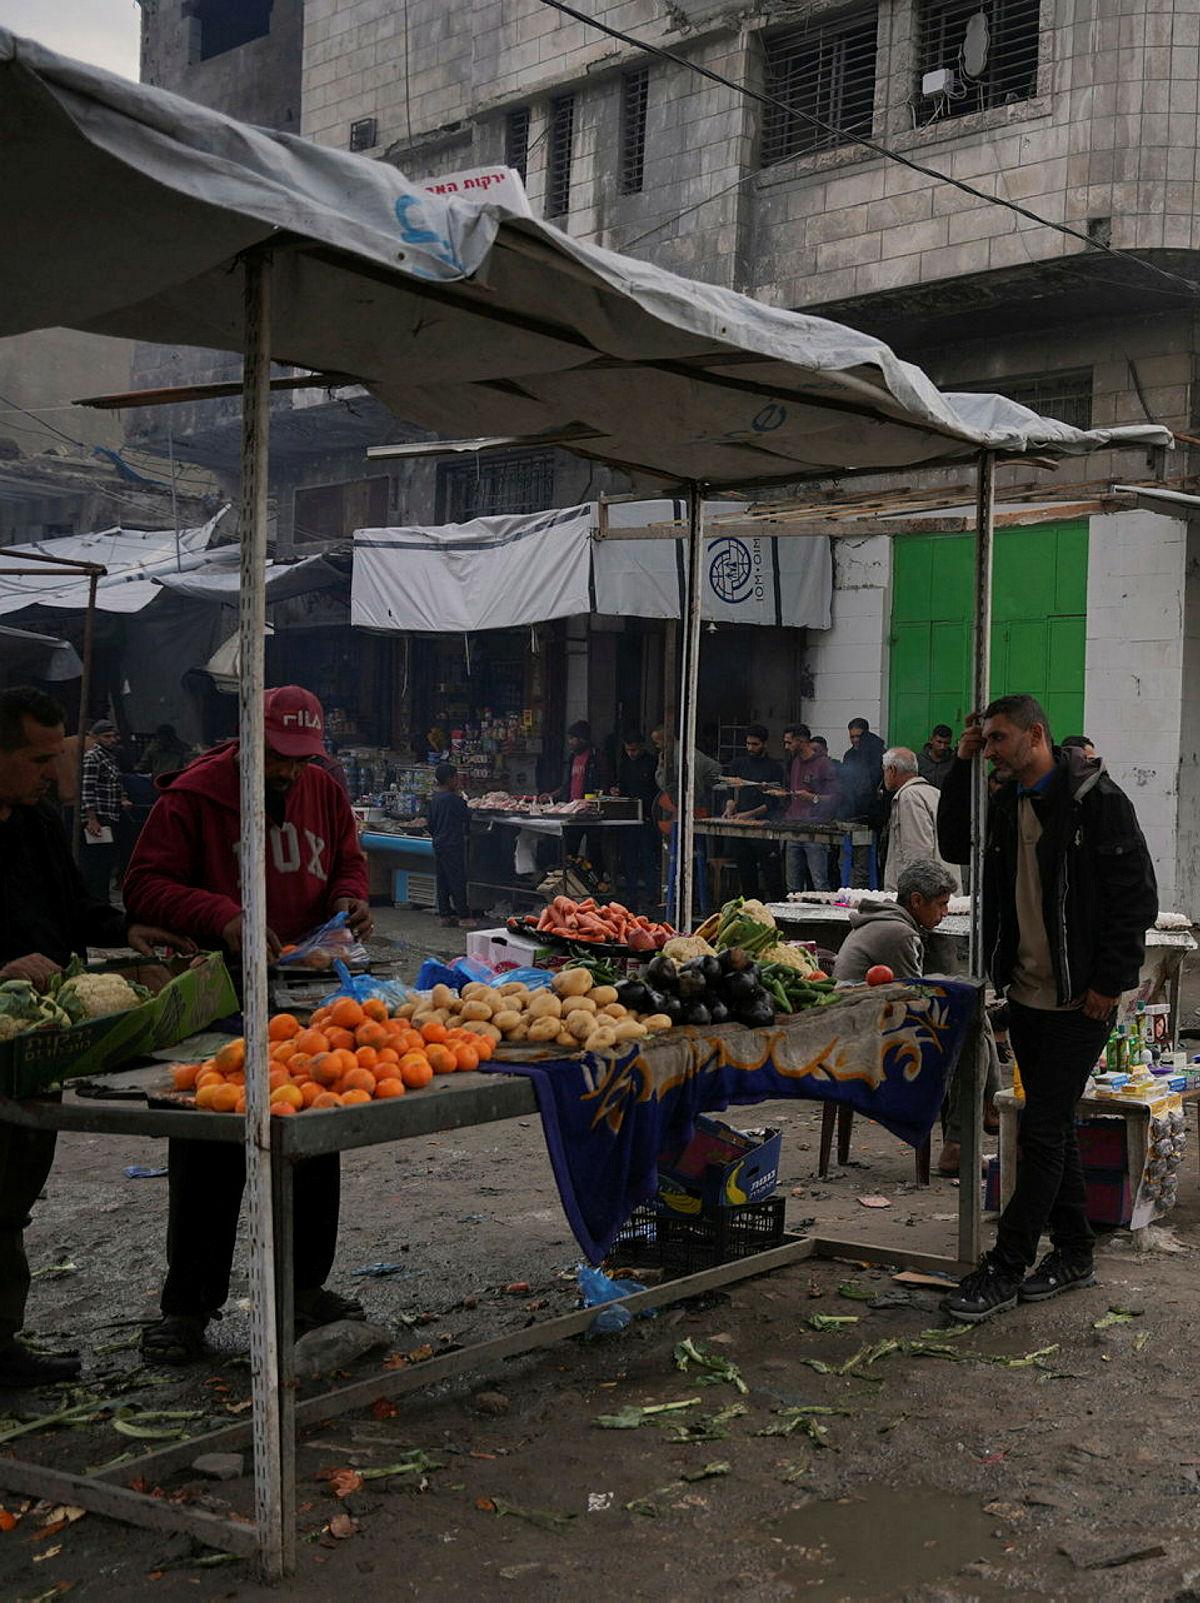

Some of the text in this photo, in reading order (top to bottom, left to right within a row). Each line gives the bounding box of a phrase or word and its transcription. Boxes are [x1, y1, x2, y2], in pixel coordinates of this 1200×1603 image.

[463, 173, 506, 190] ירקות
[754, 575, 764, 601] IOM
[232, 821, 328, 888] OX
